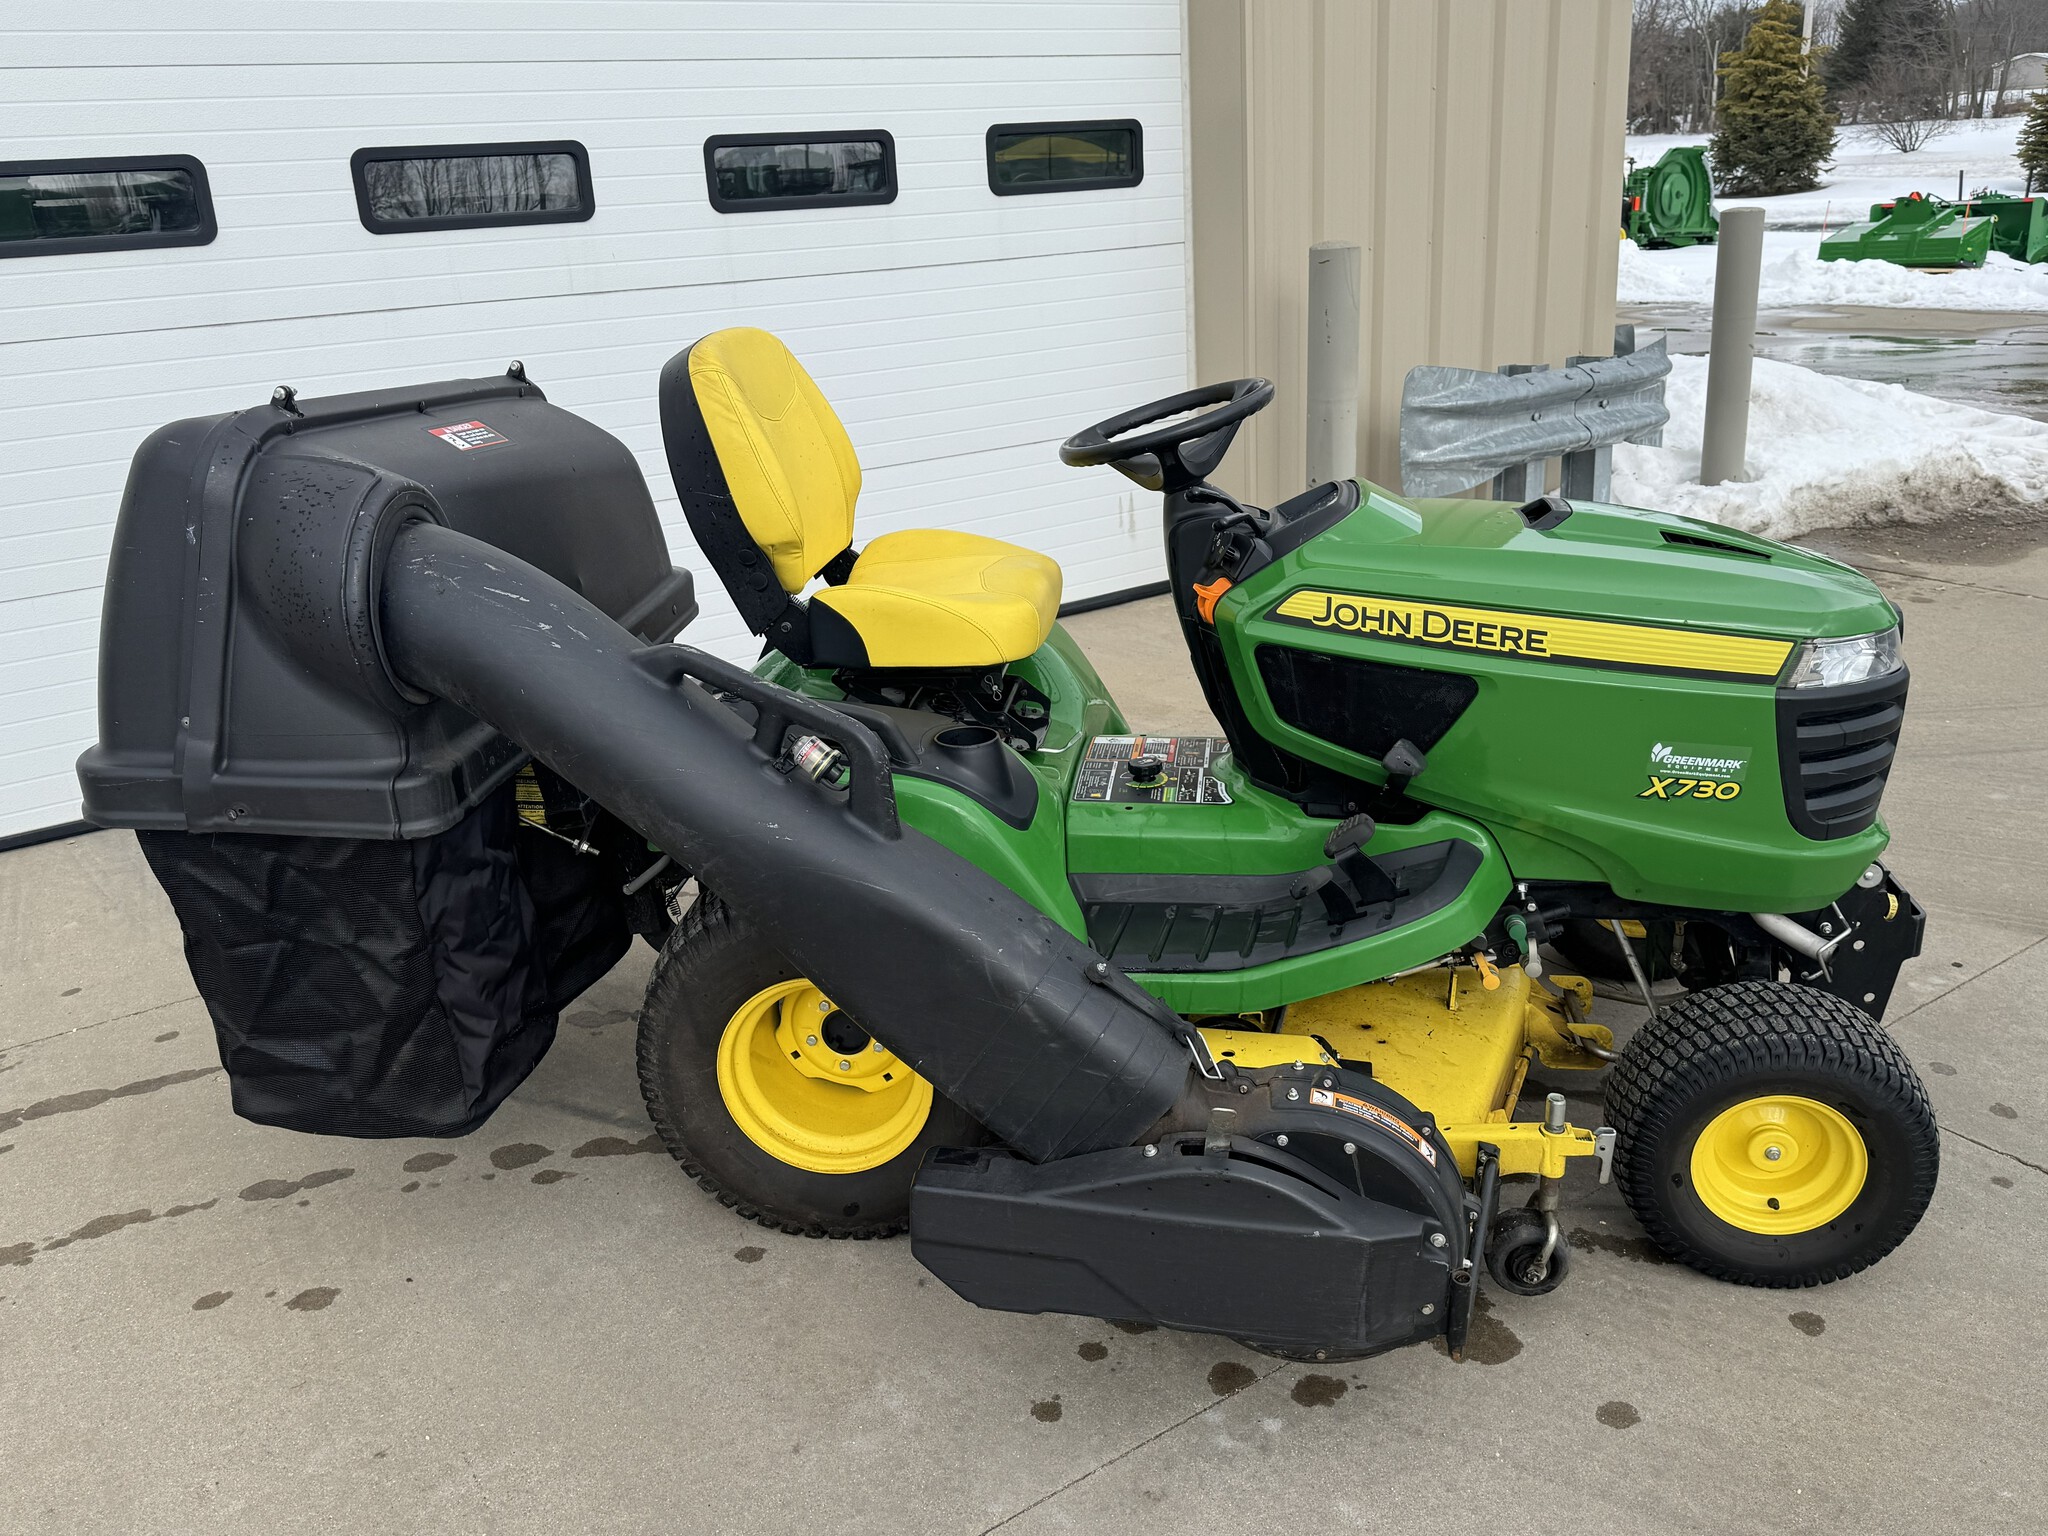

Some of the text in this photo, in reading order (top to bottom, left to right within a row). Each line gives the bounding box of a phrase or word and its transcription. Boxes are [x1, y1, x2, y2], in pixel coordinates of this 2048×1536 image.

[1312, 596, 1549, 655] JOHN DEERE
[1662, 754, 1744, 769] GREENMARK
[1666, 763, 1735, 774] EQUIPMENT
[1638, 776, 1741, 800] X730
